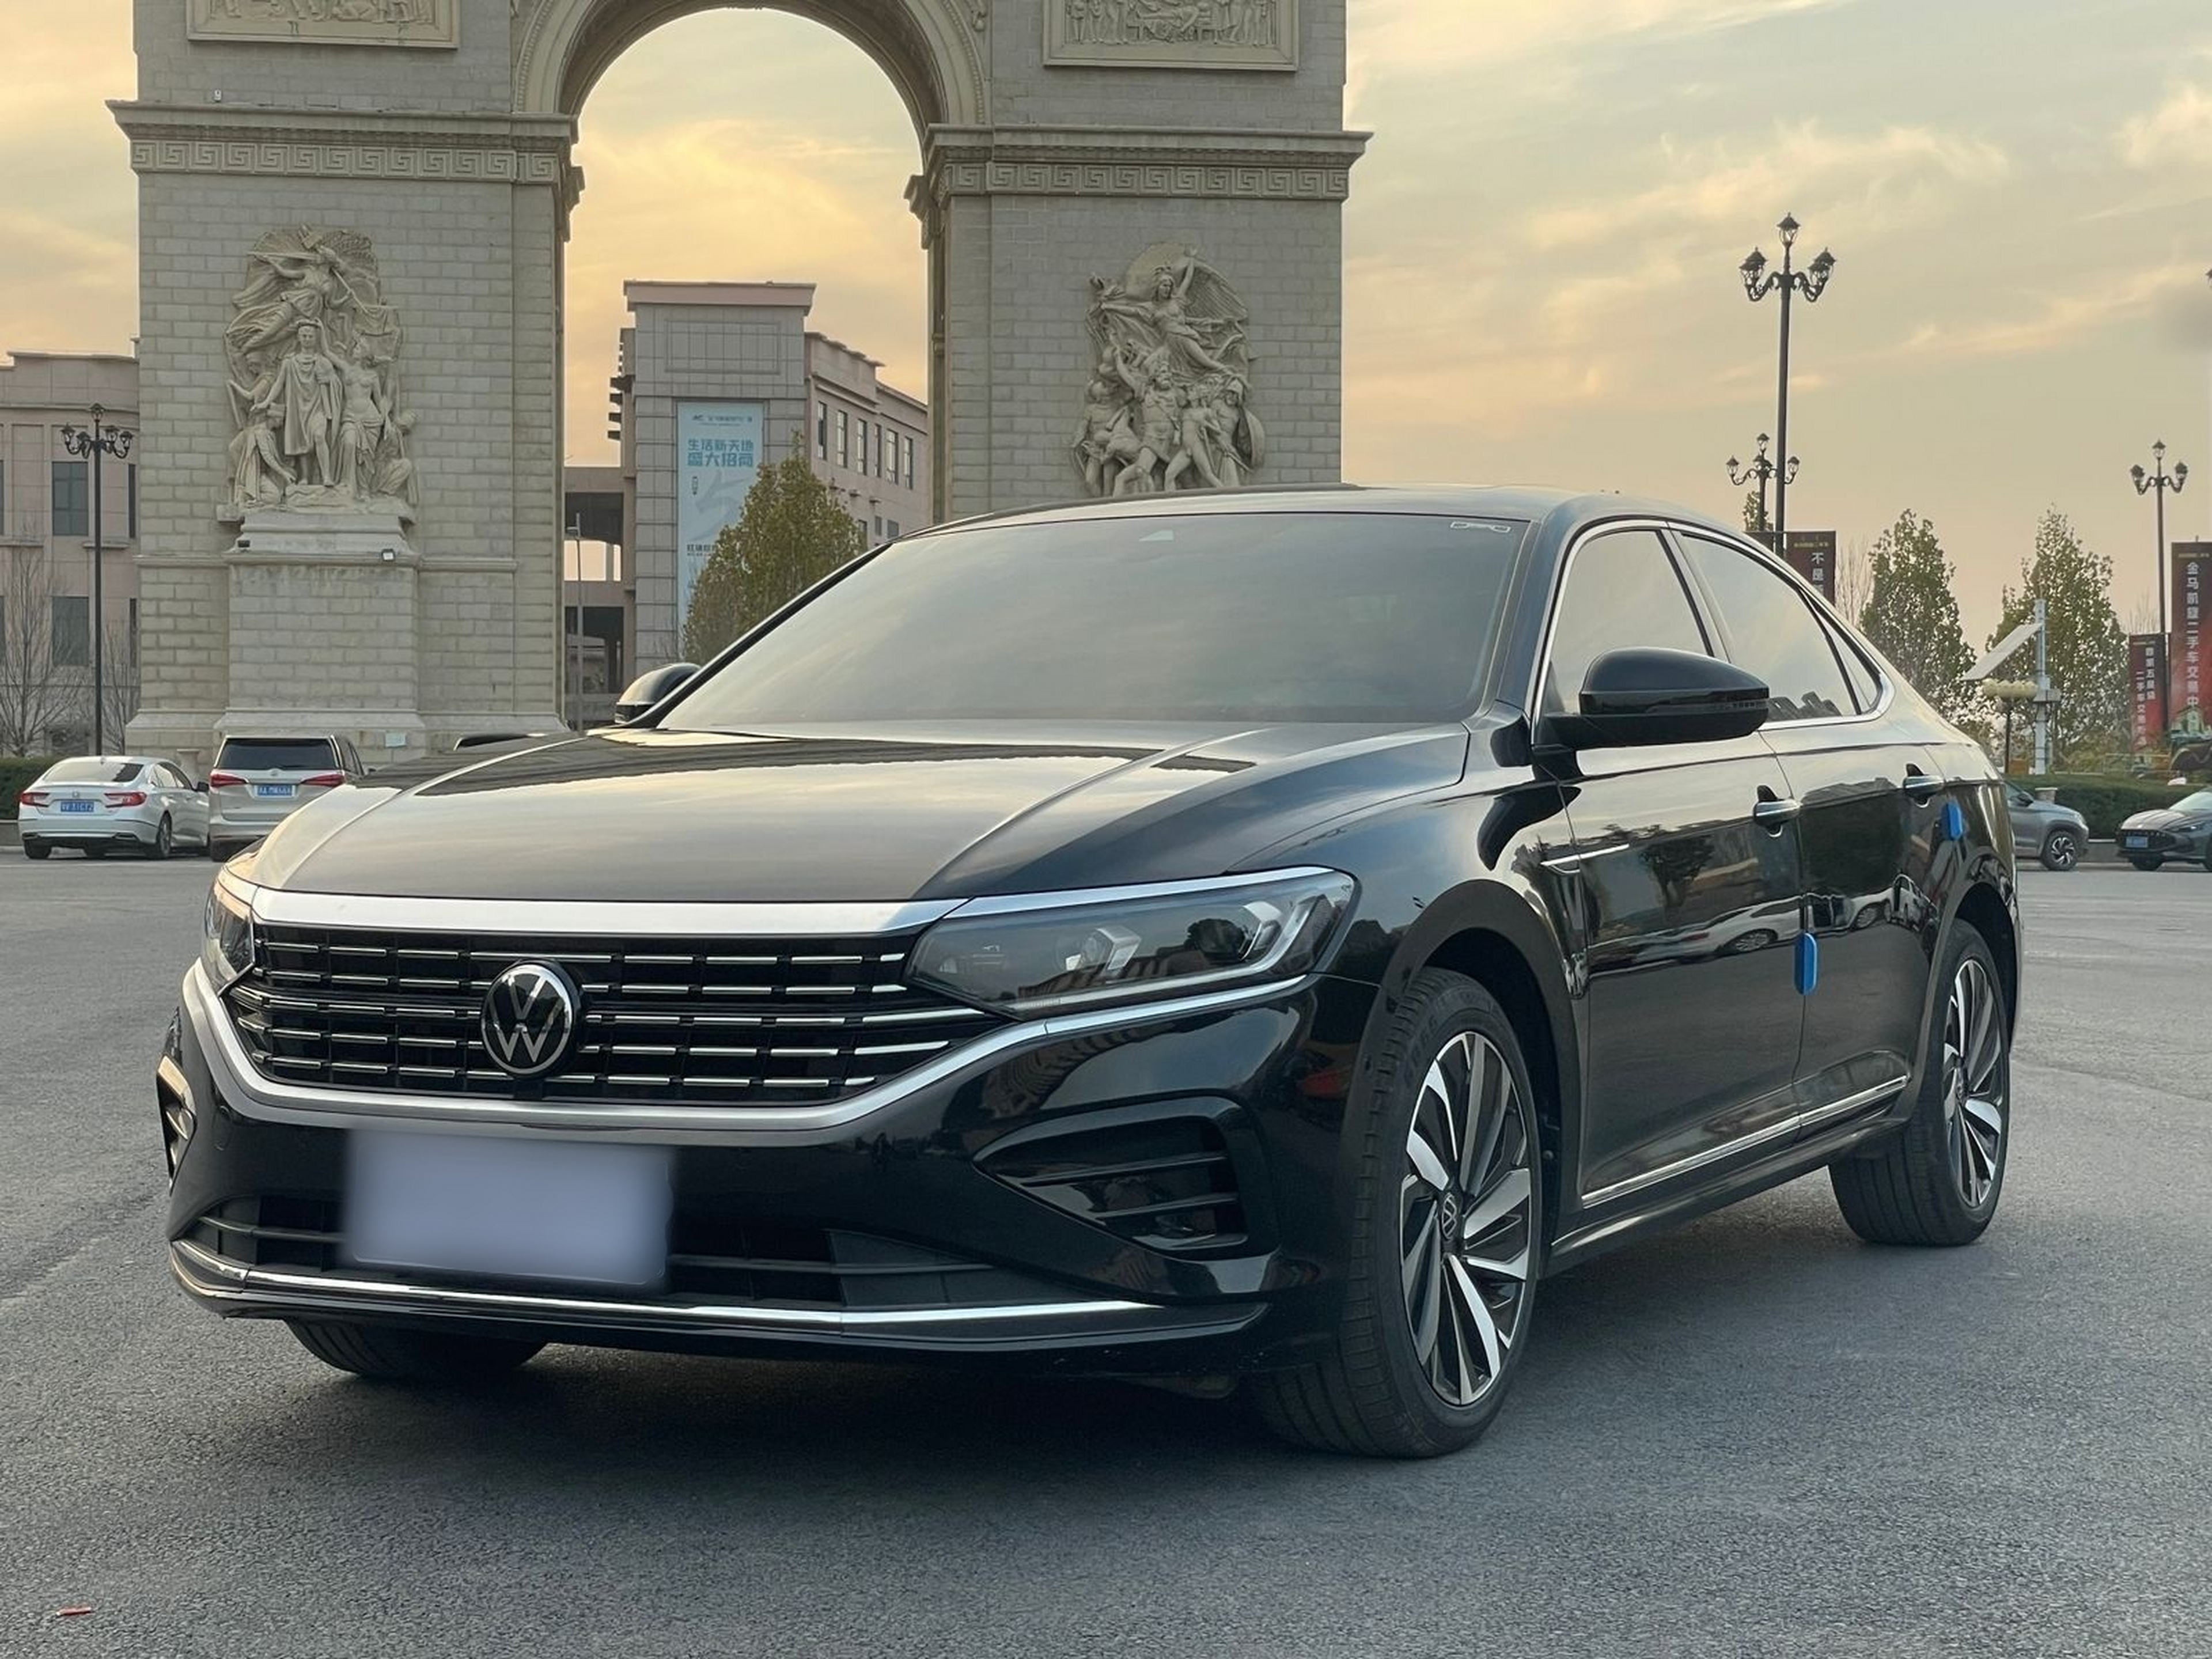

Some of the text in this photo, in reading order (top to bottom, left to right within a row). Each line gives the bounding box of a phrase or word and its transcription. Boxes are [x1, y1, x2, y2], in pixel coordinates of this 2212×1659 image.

[687, 439, 753, 452] 生活新天地
[687, 453, 753, 467] 盛大招商
